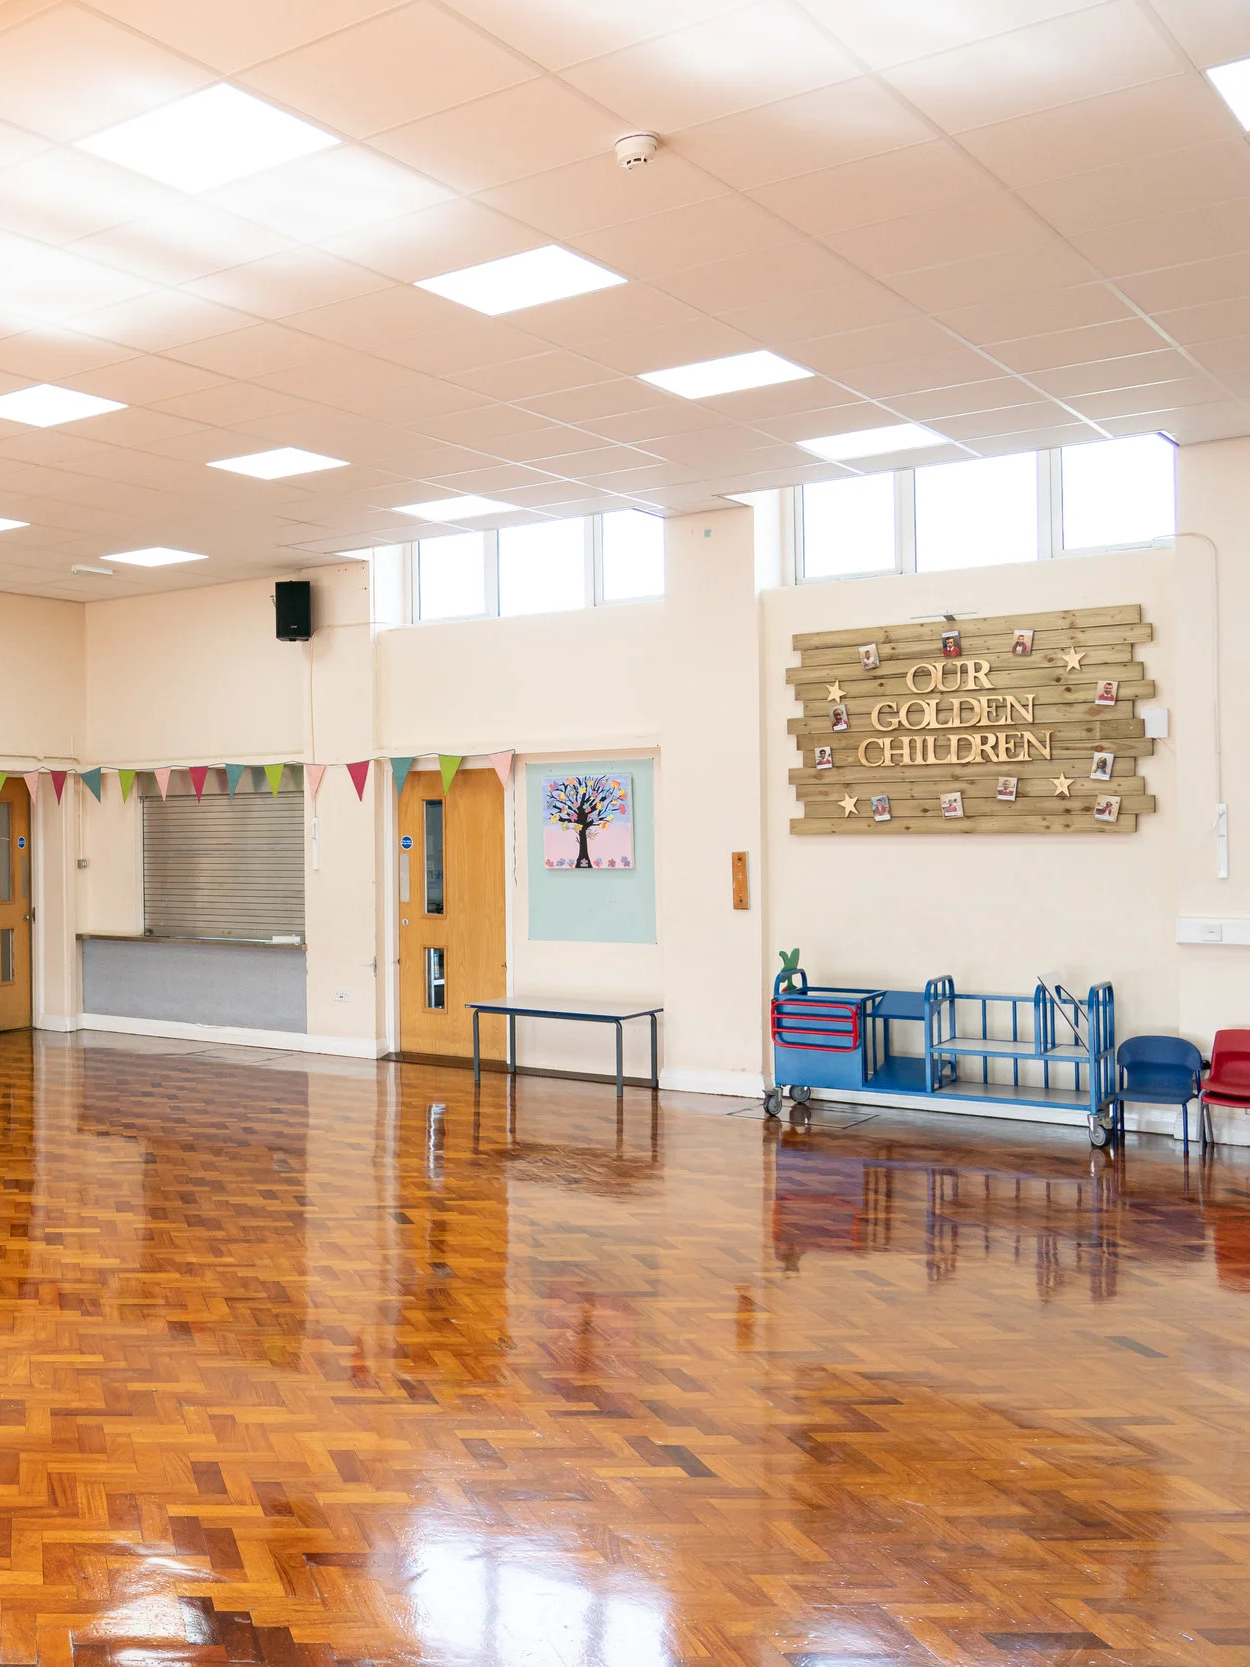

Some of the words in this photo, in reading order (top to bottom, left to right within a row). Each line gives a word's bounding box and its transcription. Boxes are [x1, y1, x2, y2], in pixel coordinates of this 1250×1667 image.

[905, 659, 996, 694] OUR
[871, 694, 1036, 731] GOLDEN
[858, 730, 1054, 767] CHILDREN
